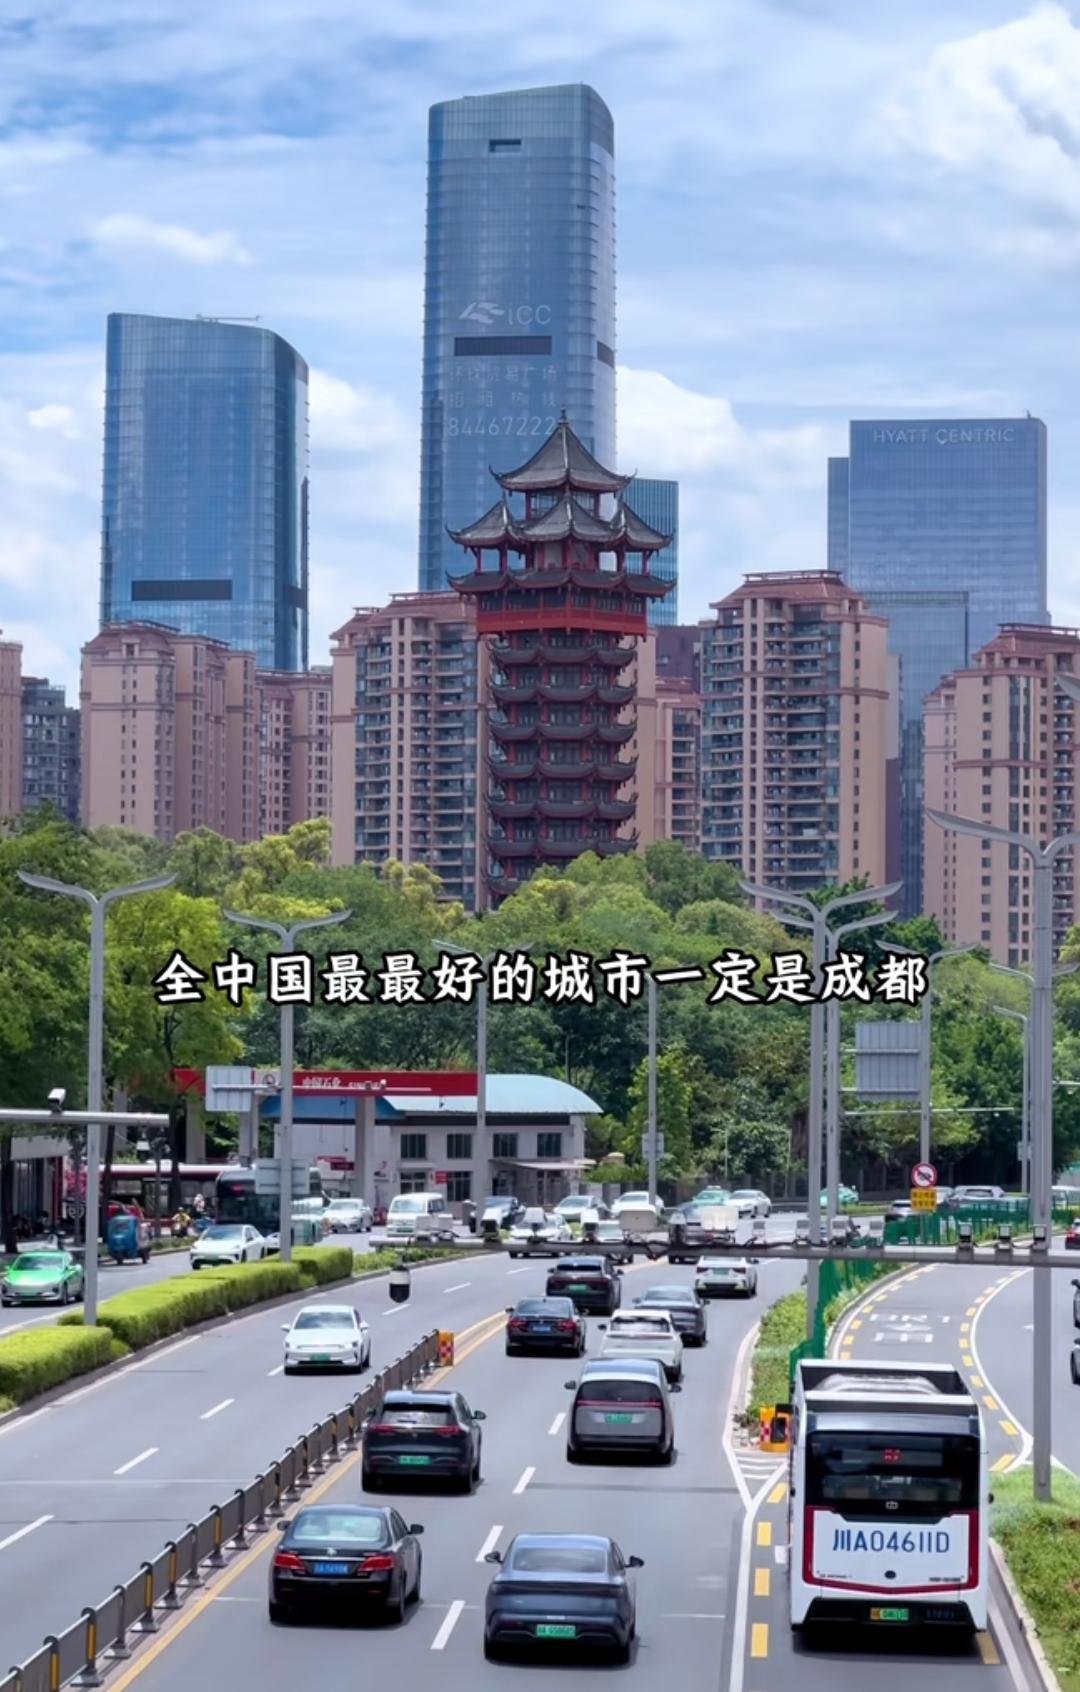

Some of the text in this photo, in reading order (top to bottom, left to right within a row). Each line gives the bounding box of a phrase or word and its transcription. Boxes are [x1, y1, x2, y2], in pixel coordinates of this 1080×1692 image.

[449, 416, 556, 437] 84467222
[872, 427, 1015, 445] HYATT CENTRIC
